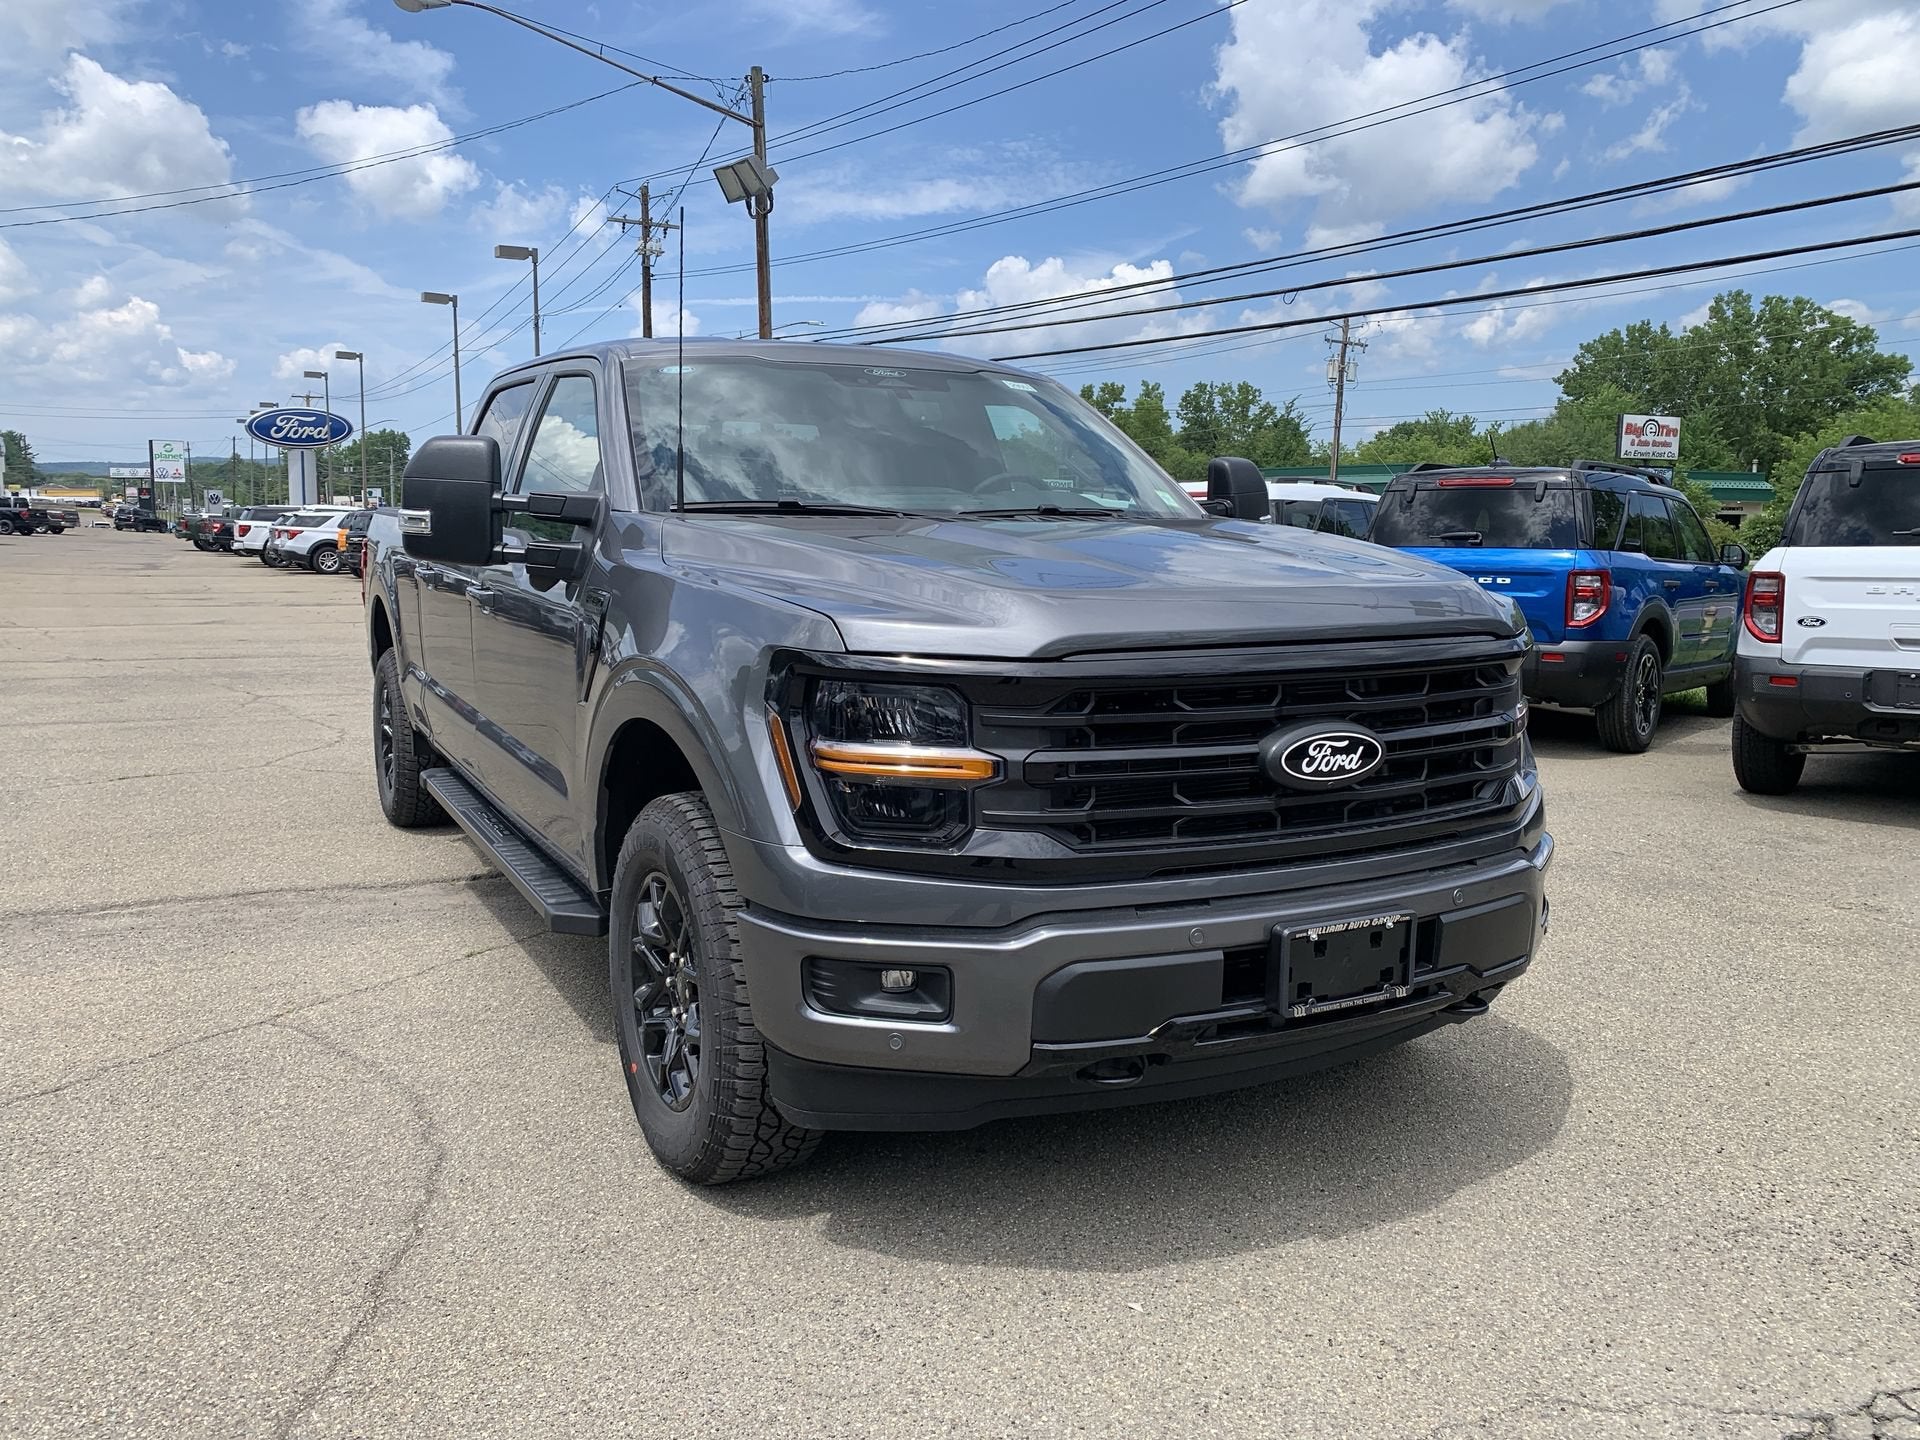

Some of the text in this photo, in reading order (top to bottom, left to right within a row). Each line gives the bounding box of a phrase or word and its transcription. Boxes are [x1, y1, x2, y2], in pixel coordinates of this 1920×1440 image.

[270, 415, 332, 439] Ford
[1624, 422, 1678, 438] Big Tire
[154, 452, 183, 460] planet
[1801, 617, 1822, 627] Ford
[1301, 740, 1364, 773] Ford
[1348, 919, 1370, 930] AUTO
[1311, 1003, 1340, 1014] PARTNERING
[1341, 1000, 1354, 1008] WITH
